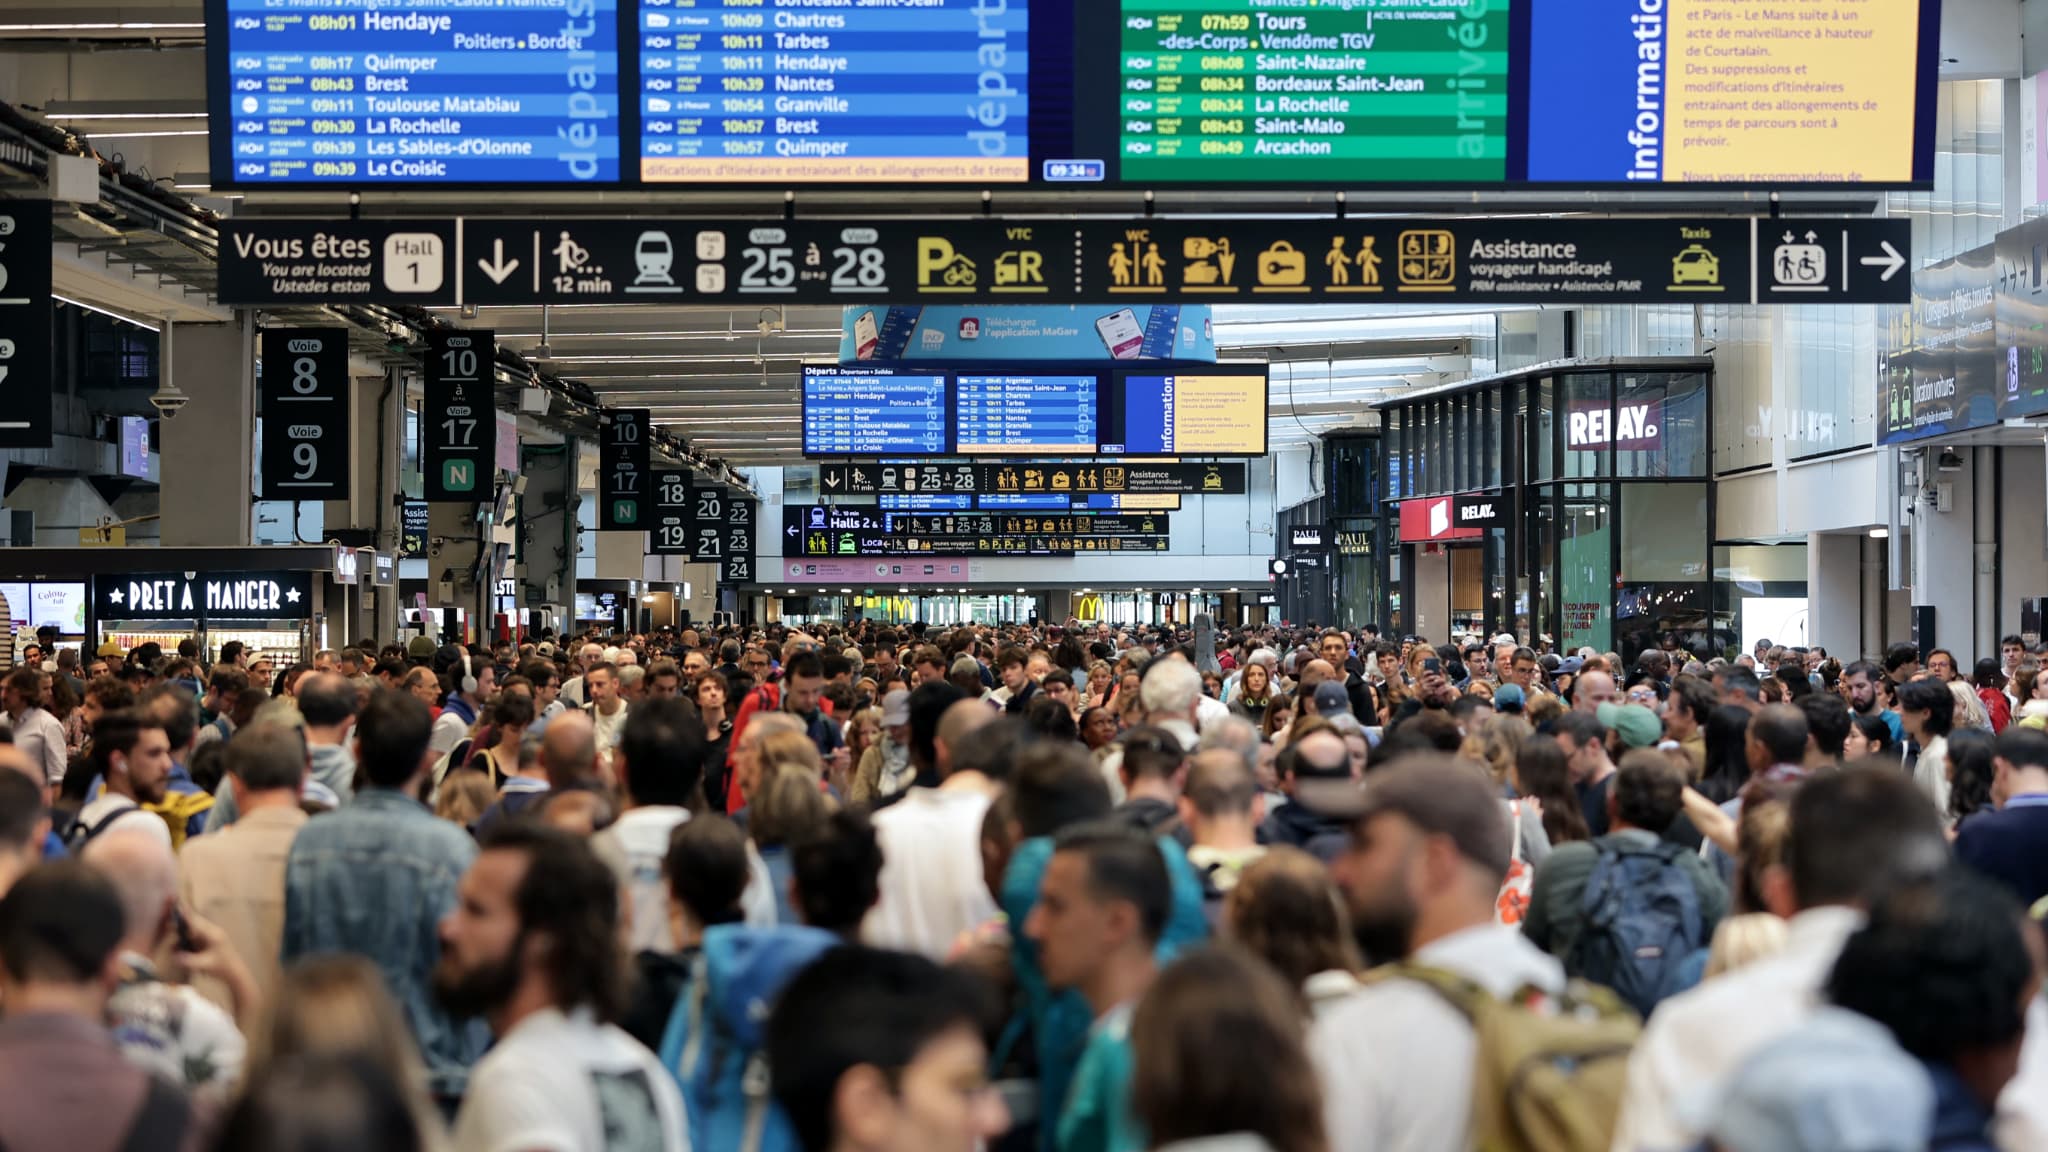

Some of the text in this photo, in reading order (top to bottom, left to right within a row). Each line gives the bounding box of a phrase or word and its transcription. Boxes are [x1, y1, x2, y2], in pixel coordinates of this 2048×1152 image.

[309, 15, 356, 30] 08h01
[364, 12, 451, 34] Hendaye
[774, 12, 845, 28] Chartres
[1201, 15, 1249, 30] 07h59
[1255, 13, 1306, 30] Tours
[1687, 10, 1699, 21] et
[1703, 10, 1732, 21] Paris
[1744, 10, 1759, 21] Le
[1762, 10, 1795, 21] Mans
[1798, 10, 1828, 21] suite
[1842, 12, 1858, 21] un
[454, 33, 515, 49] Poitiers
[774, 33, 829, 49] Tarbes
[1686, 29, 1712, 39] acte
[1716, 28, 1731, 39] de
[1734, 28, 1811, 39] malveillance
[1825, 28, 1873, 39] hauteur
[1158, 33, 1375, 51] -des-Corps Vendôme TGV
[1686, 46, 1700, 57] de
[310, 56, 354, 70] 08h17
[364, 54, 437, 73] Quimper
[775, 54, 848, 74] Hendaye
[1255, 54, 1366, 70] Saint-Nazaire
[1685, 64, 1807, 78] Des suppressions et
[365, 76, 408, 92] Brest
[775, 75, 834, 91] Nantes
[1255, 76, 1332, 92] Bordeaux
[1336, 75, 1424, 92] Saint-Jean
[1685, 82, 1769, 93] modifications
[365, 96, 440, 113] Toulouse
[444, 96, 520, 113] Matabiau
[775, 96, 848, 113] Granville
[1255, 97, 1274, 112] La
[1278, 96, 1349, 113] Rochelle
[366, 118, 386, 134] La
[390, 118, 461, 134] Rochelle
[775, 117, 819, 134] Brest
[1254, 117, 1344, 134] Saint-Malo
[367, 139, 395, 155] Les
[398, 138, 532, 155] Sables-d'Olonne
[775, 138, 848, 157] Quimper
[1254, 139, 1331, 155] Arcachon
[367, 160, 388, 176] Le
[390, 160, 446, 176] Croisic
[1006, 228, 1032, 240] VTC
[1126, 230, 1148, 242] WC
[1680, 227, 1711, 239] Taxis
[233, 232, 370, 258] Vous êtes
[395, 240, 432, 255] Hall
[1469, 240, 1576, 258] Assistance
[741, 241, 886, 286] 25 à 28
[918, 237, 954, 285] P
[1469, 261, 1612, 277] voyageur handicapé
[262, 263, 370, 278] You are located
[406, 263, 420, 284] 1
[272, 280, 329, 293] Ustedes
[552, 276, 611, 293] 12 min
[1470, 281, 1494, 291] PRM
[1617, 281, 1642, 291] PMR
[985, 317, 1036, 328] Téléchargez
[985, 327, 1079, 338] l'application MaGare
[292, 341, 318, 352] Voie
[450, 338, 469, 347] Voie
[442, 350, 477, 377] 10
[292, 357, 318, 394] 8
[455, 384, 463, 396] à
[854, 393, 885, 401] Hendaye
[450, 406, 469, 415] Voie
[1074, 379, 1092, 443] départs
[1161, 377, 1173, 452] information
[923, 387, 941, 451] départs
[1570, 405, 1657, 445] RELAY
[292, 426, 318, 437] Voie
[441, 419, 477, 445] 17
[612, 423, 638, 441] 10
[293, 443, 318, 480] 9
[450, 465, 467, 485] N
[612, 472, 638, 490] 17
[921, 475, 974, 488] 25 28
[1130, 471, 1169, 479] Assistance
[659, 484, 685, 503] 18
[619, 505, 631, 518] N
[697, 500, 720, 517] 20
[730, 508, 748, 521] 22
[1462, 504, 1494, 520] RELAY
[831, 518, 860, 529] Halls
[863, 518, 870, 528] 2
[659, 526, 685, 545] 19
[730, 535, 748, 549] 23
[1339, 533, 1370, 545] PAUL
[697, 538, 721, 555] 21
[730, 563, 748, 576] 24
[129, 581, 175, 610] PRET
[207, 580, 280, 610] MANGER
